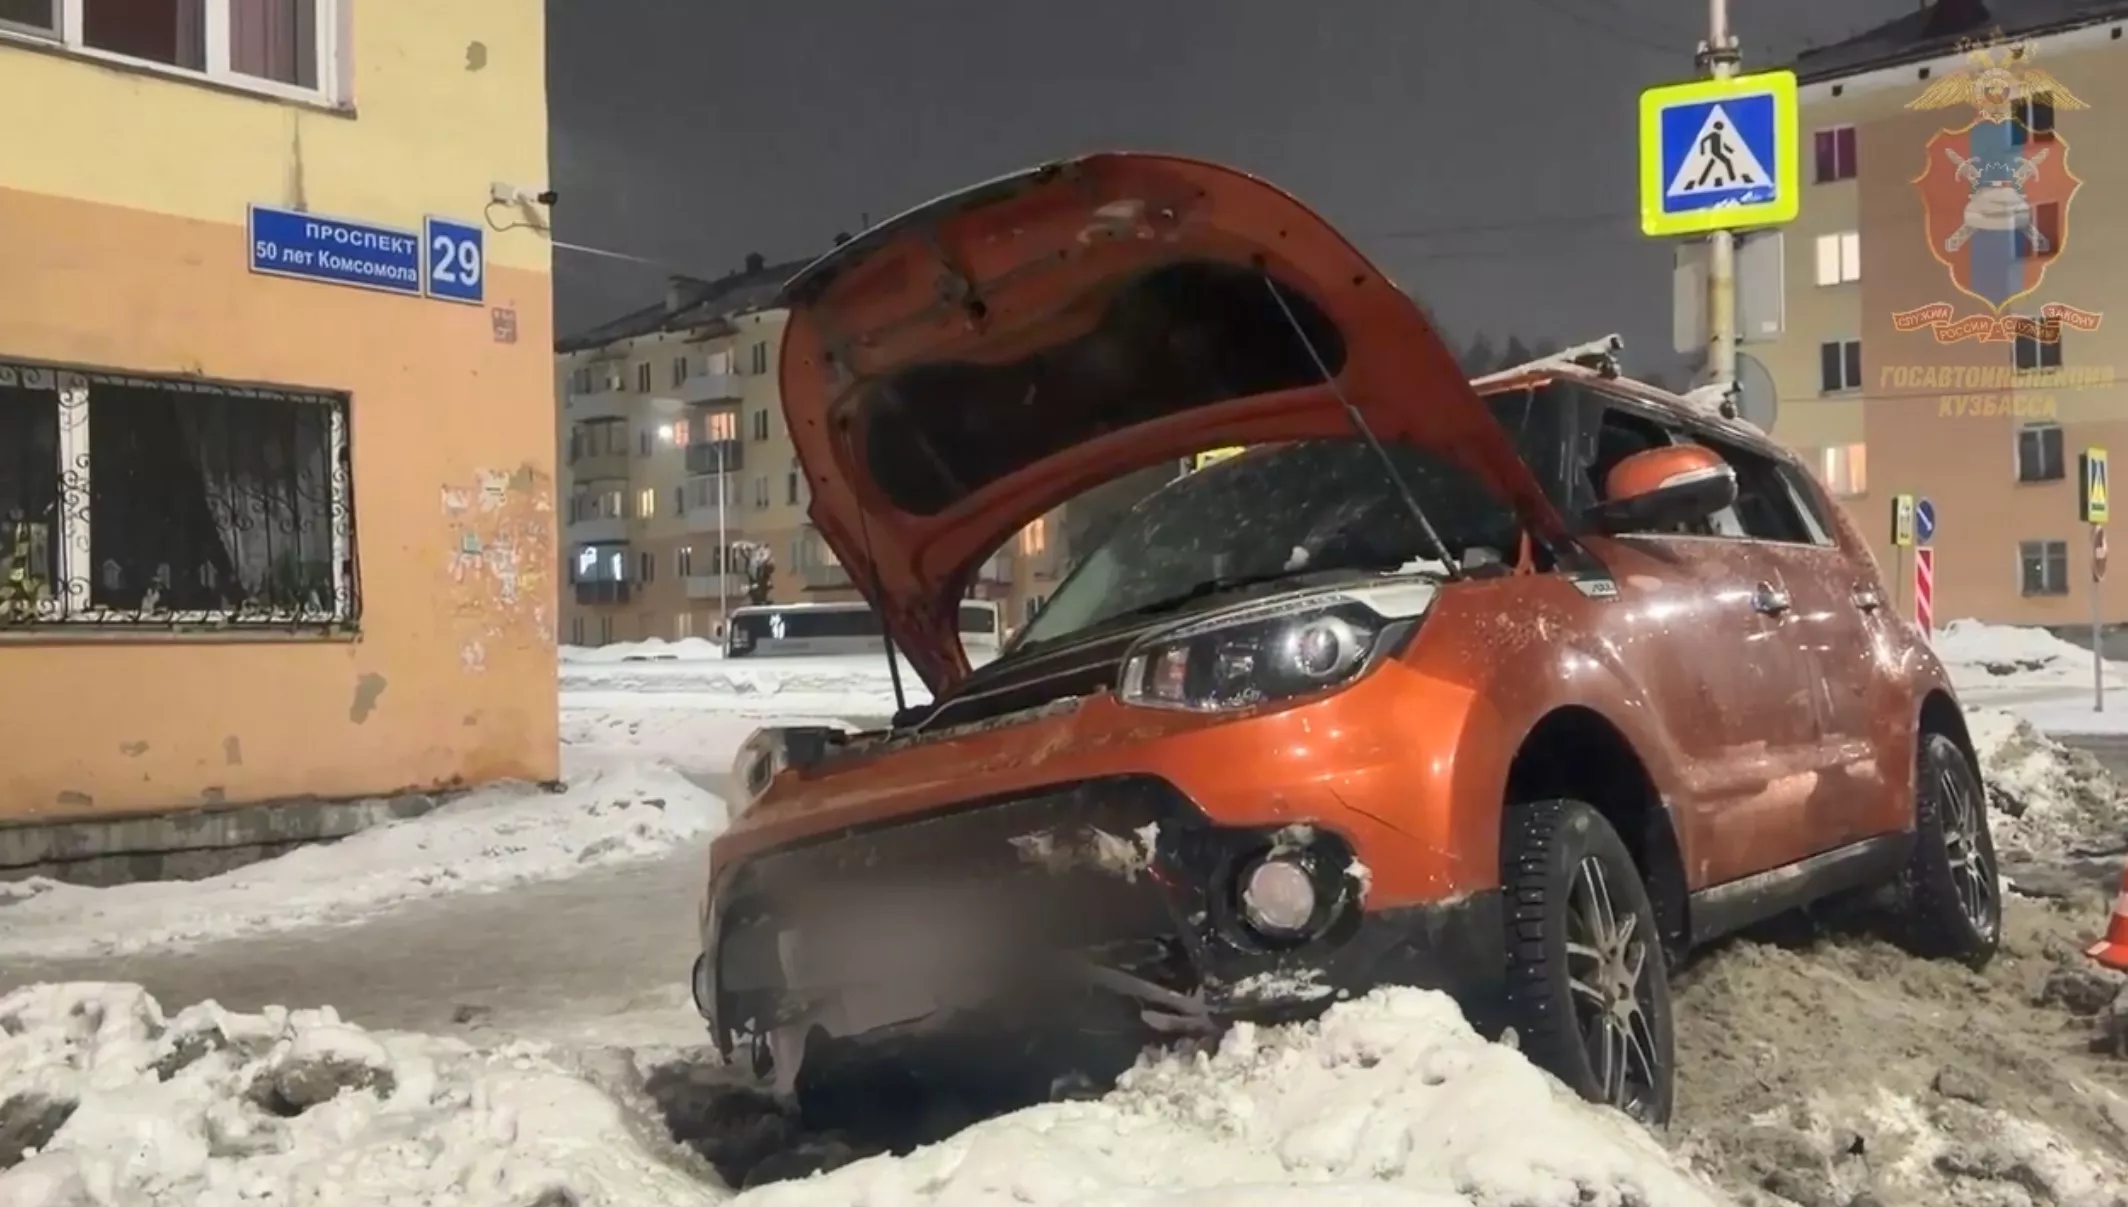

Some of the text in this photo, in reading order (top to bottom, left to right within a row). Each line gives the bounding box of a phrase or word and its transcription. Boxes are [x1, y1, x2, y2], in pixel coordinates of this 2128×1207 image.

[305, 223, 415, 255] ПРОСПЕКТ
[256, 240, 417, 282] 50 лет Комсомола
[432, 235, 480, 286] 29
